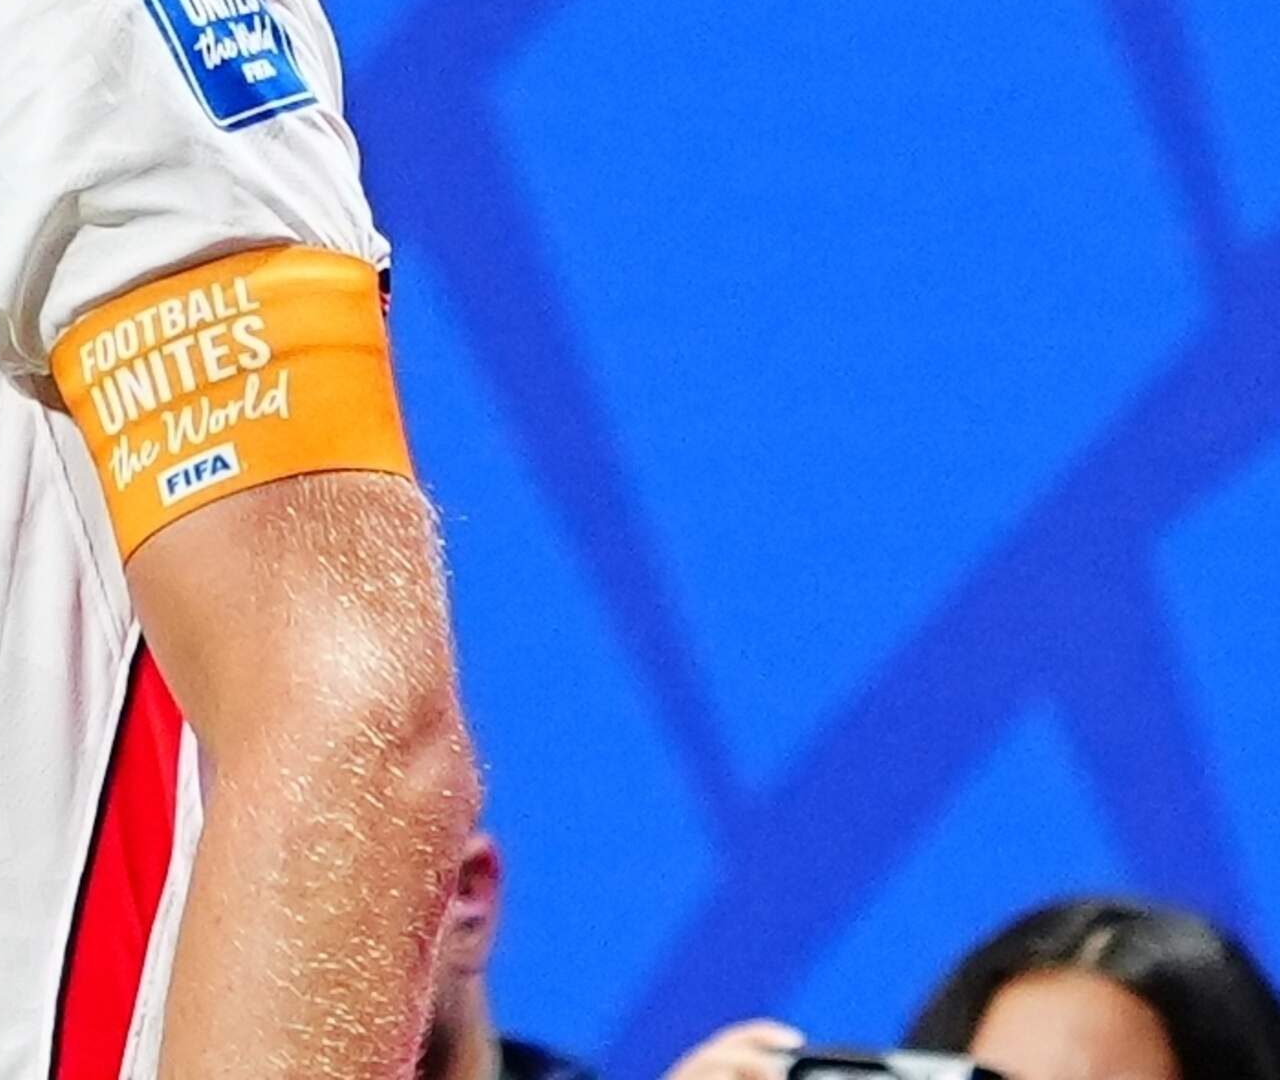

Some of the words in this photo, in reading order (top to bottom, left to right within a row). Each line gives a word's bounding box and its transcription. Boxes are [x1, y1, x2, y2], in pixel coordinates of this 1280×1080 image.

[192, 26, 240, 70] the
[79, 277, 259, 384] FOOTBALL
[90, 314, 272, 435] UNITES
[109, 435, 160, 491] the
[162, 369, 289, 454] World
[165, 453, 232, 497] FIFA
